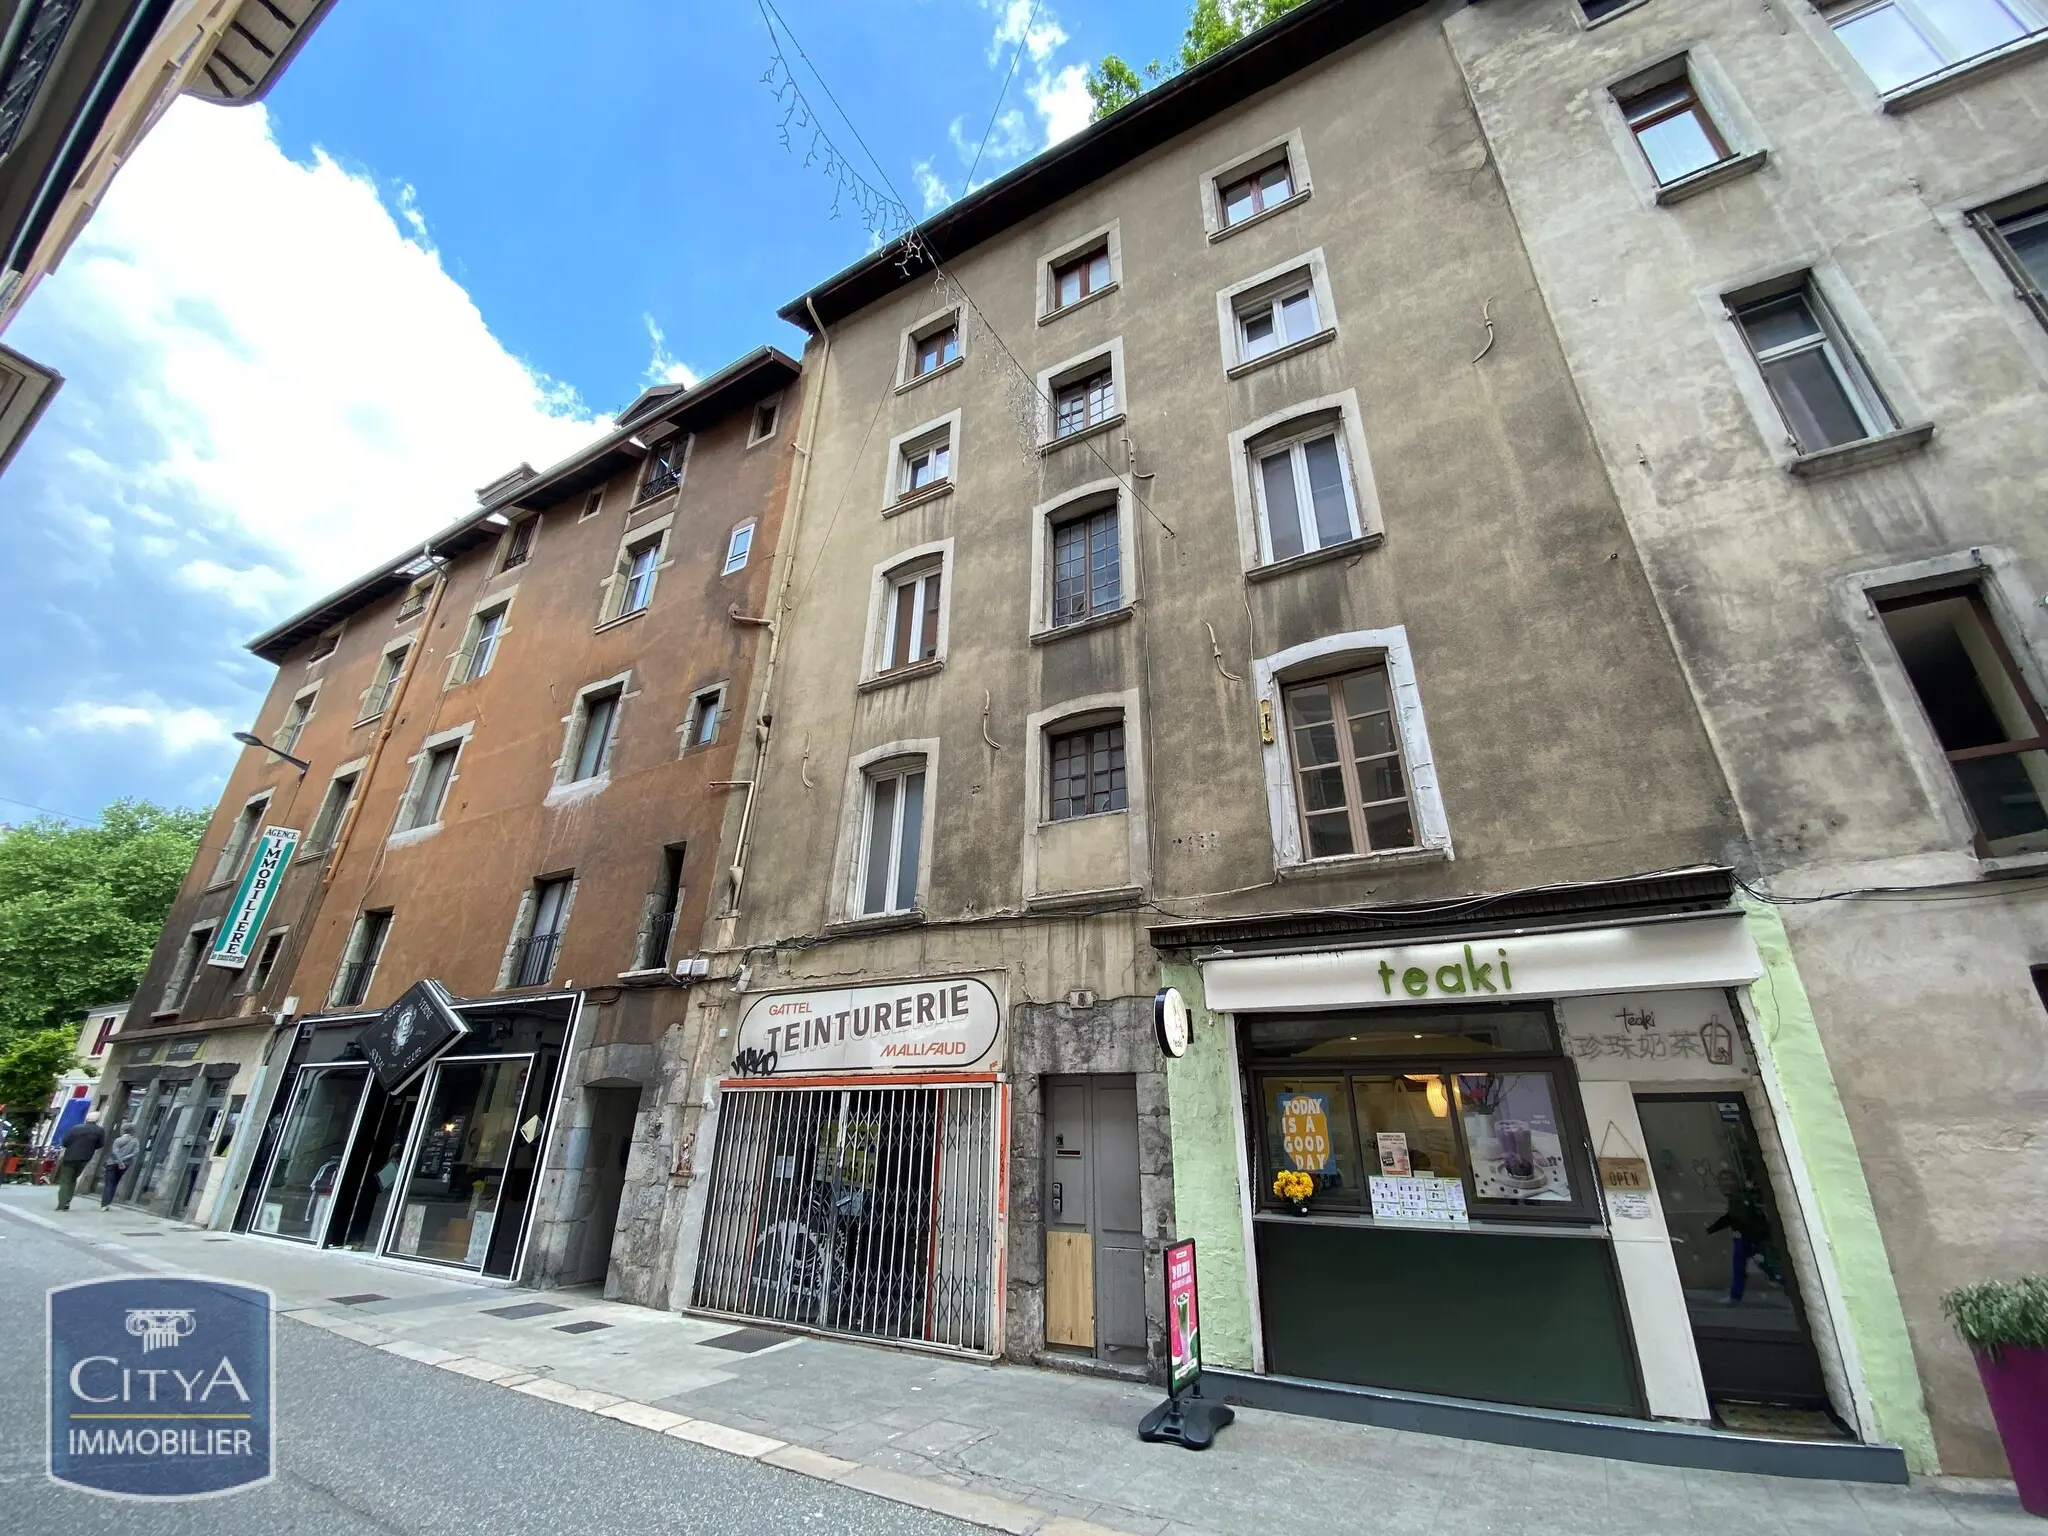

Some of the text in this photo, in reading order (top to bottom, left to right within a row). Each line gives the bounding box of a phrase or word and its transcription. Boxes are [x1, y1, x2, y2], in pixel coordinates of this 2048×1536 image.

[266, 828, 298, 840] AGENCE
[225, 839, 282, 954] IMMOBILIERE
[1377, 943, 1512, 996] teaki
[769, 1002, 812, 1016] GATTEL
[766, 984, 969, 1054] TEINTURERIE
[880, 1041, 966, 1057] MALLIFAUD
[1572, 1031, 1701, 1061] 珍珠奶茶
[1282, 1098, 1323, 1116] TODAY
[1282, 1115, 1316, 1134] IS A
[1283, 1135, 1325, 1153] GOOD
[1296, 1154, 1325, 1170] DAY
[1609, 1171, 1640, 1187] OPEN
